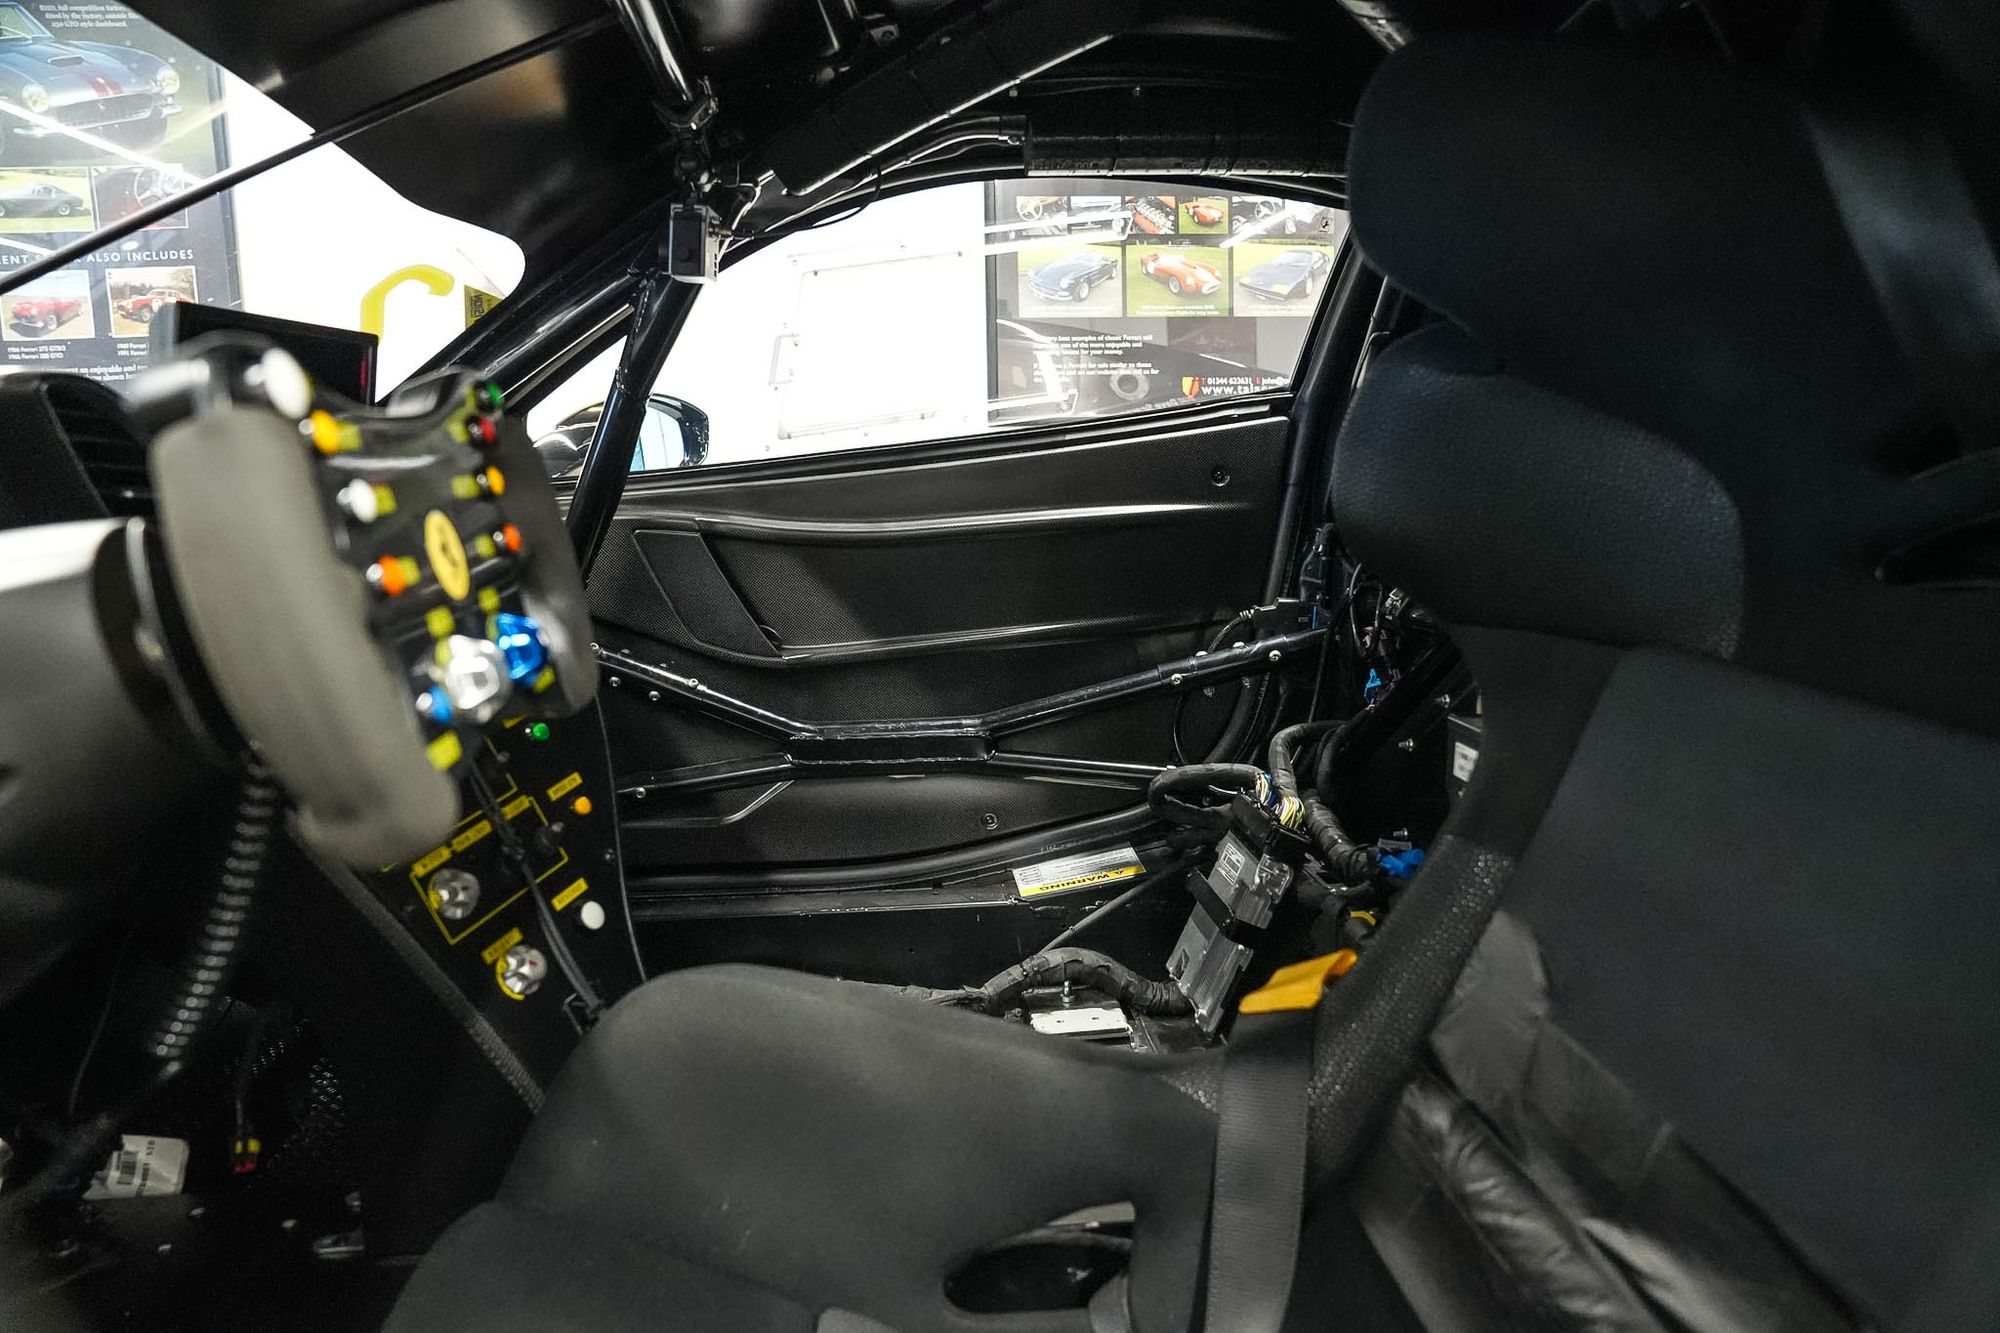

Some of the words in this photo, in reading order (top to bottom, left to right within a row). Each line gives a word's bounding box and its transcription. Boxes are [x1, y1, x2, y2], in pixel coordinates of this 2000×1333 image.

[87, 252, 121, 262] ALSO
[127, 249, 194, 261] INCLUDES
[89, 365, 122, 374] enjoyable
[1206, 376, 1228, 385] 01344
[1040, 874, 1110, 890] WARNING
